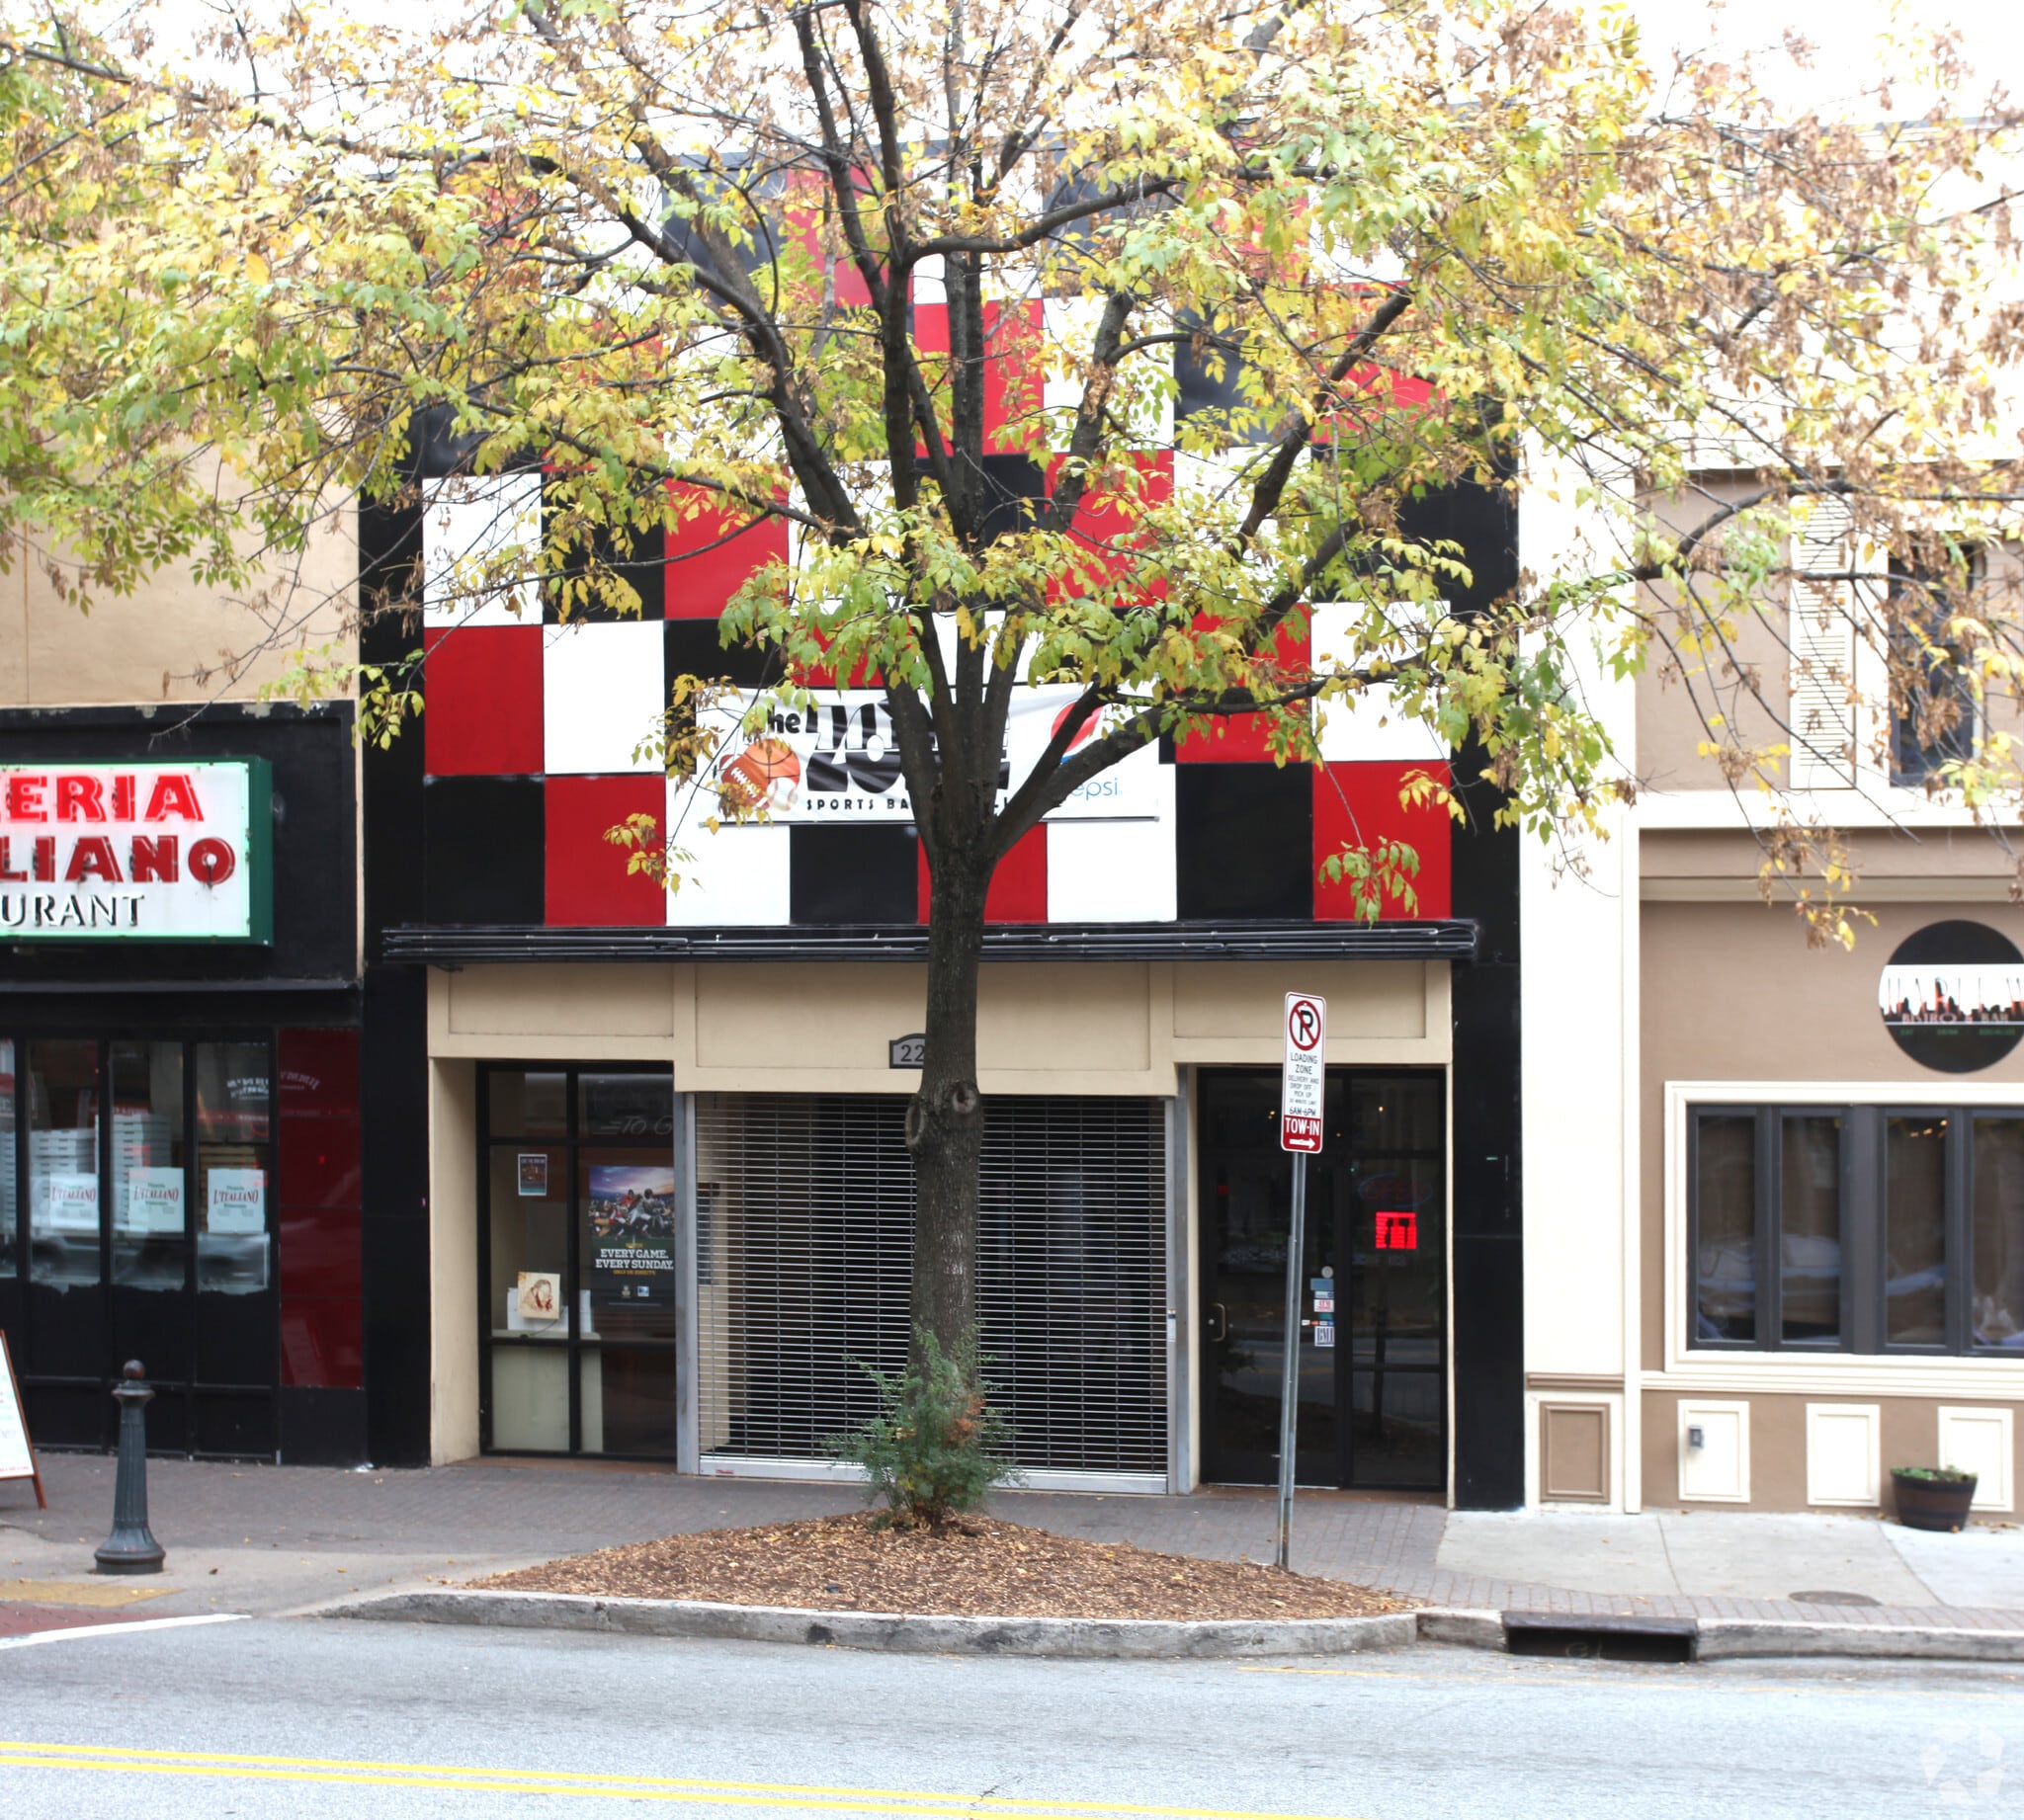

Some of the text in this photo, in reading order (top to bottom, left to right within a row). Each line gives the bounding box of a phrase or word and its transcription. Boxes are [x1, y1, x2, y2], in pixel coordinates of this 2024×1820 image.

[1070, 777, 1119, 800] epsi
[6, 775, 205, 822] ERIA
[806, 797, 909, 811] SPORTS BA
[0, 893, 145, 927] URANT
[900, 1044, 925, 1063] 22
[1290, 1052, 1318, 1065] LOADING
[1295, 1063, 1312, 1075] ZONE
[1285, 1117, 1320, 1136] TOW-IN
[600, 1248, 634, 1259] EVERY
[595, 1259, 631, 1270] EVERY
